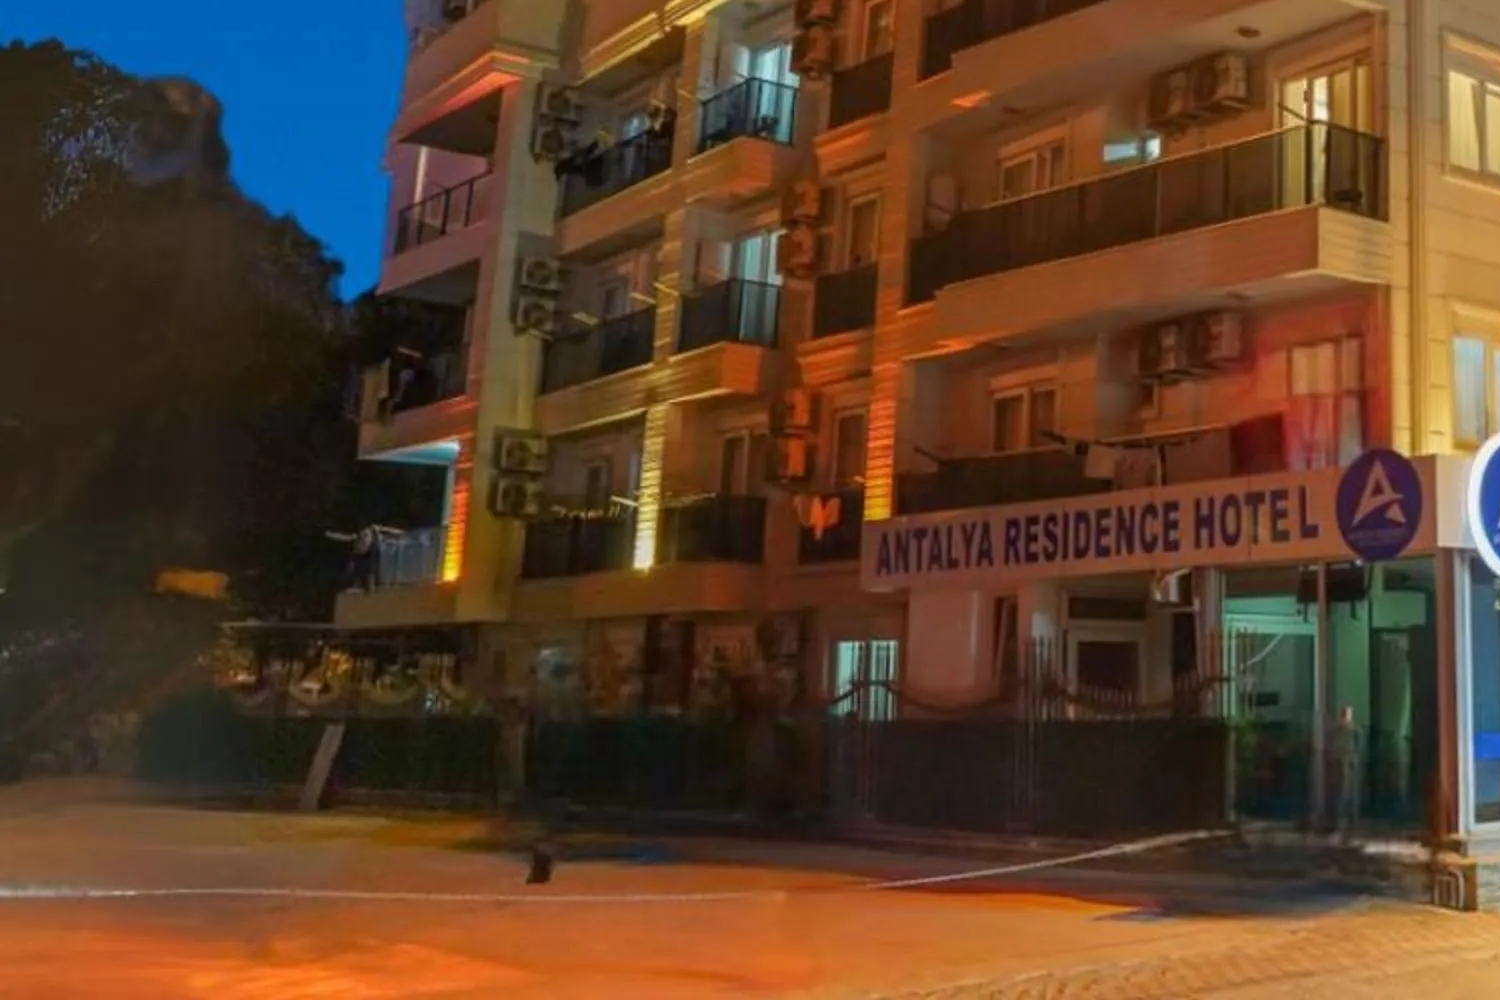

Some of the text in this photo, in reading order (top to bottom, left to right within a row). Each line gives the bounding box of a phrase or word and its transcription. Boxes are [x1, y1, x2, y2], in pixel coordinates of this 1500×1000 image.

[876, 485, 1319, 576] ANTALYA RESIDENCE HOTEL
